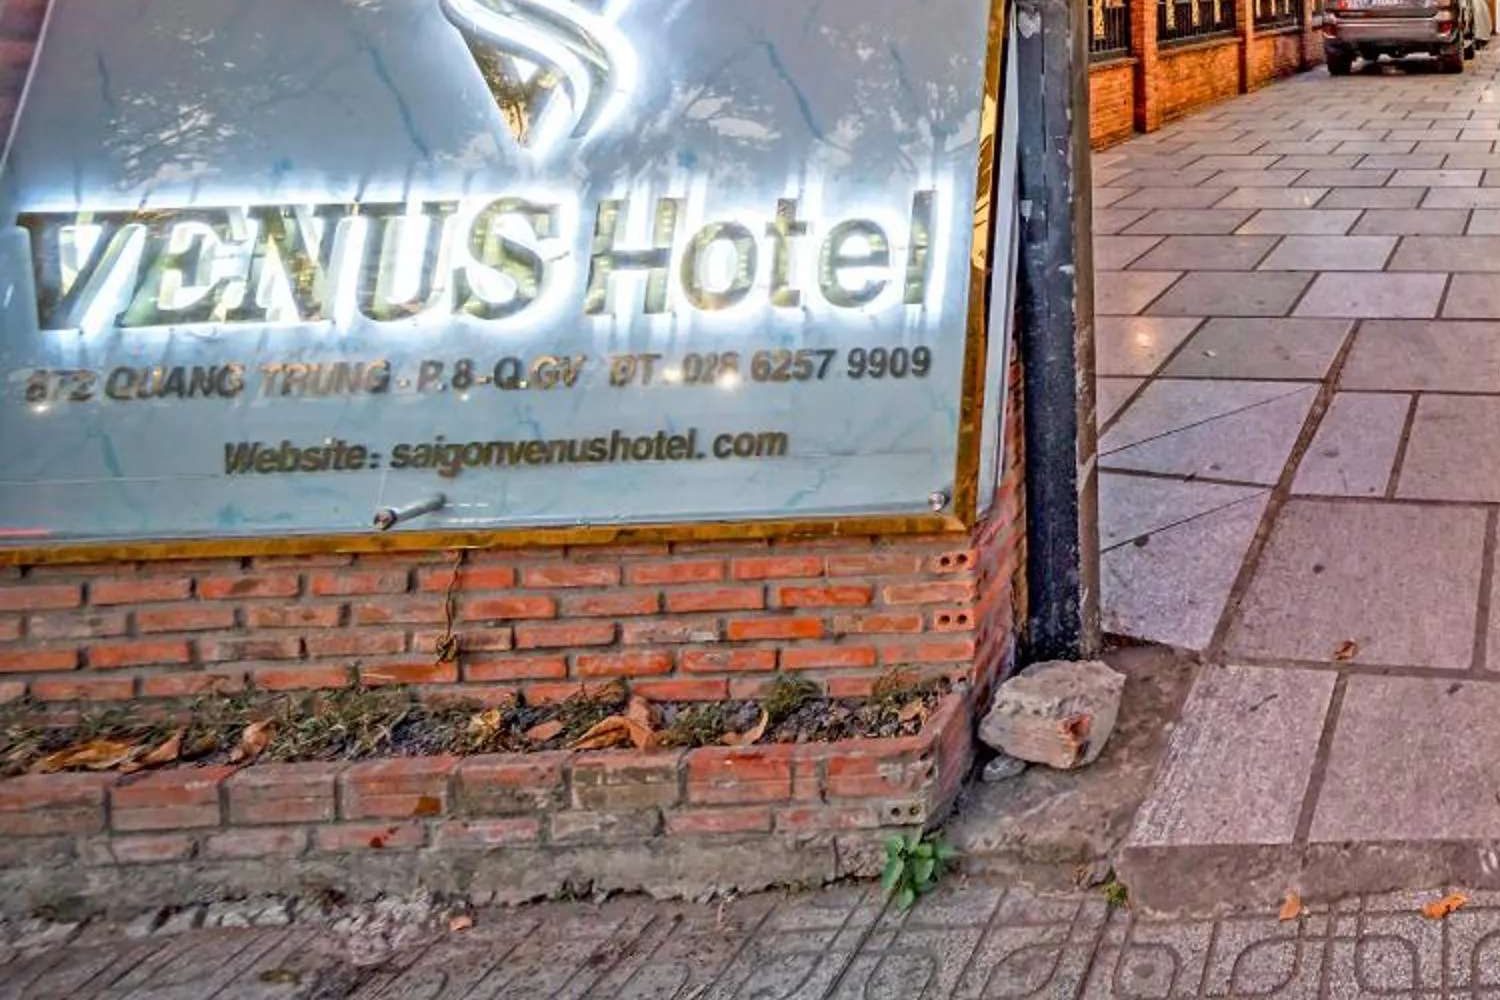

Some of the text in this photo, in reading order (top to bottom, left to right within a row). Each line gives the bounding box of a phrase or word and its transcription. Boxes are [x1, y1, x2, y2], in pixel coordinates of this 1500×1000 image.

[16, 190, 938, 331] VENUS Hotel
[105, 363, 246, 400] QUANG
[256, 359, 392, 397] TRUNG
[750, 347, 838, 383] 6257
[846, 344, 932, 379] 9909
[224, 438, 382, 475] Website:
